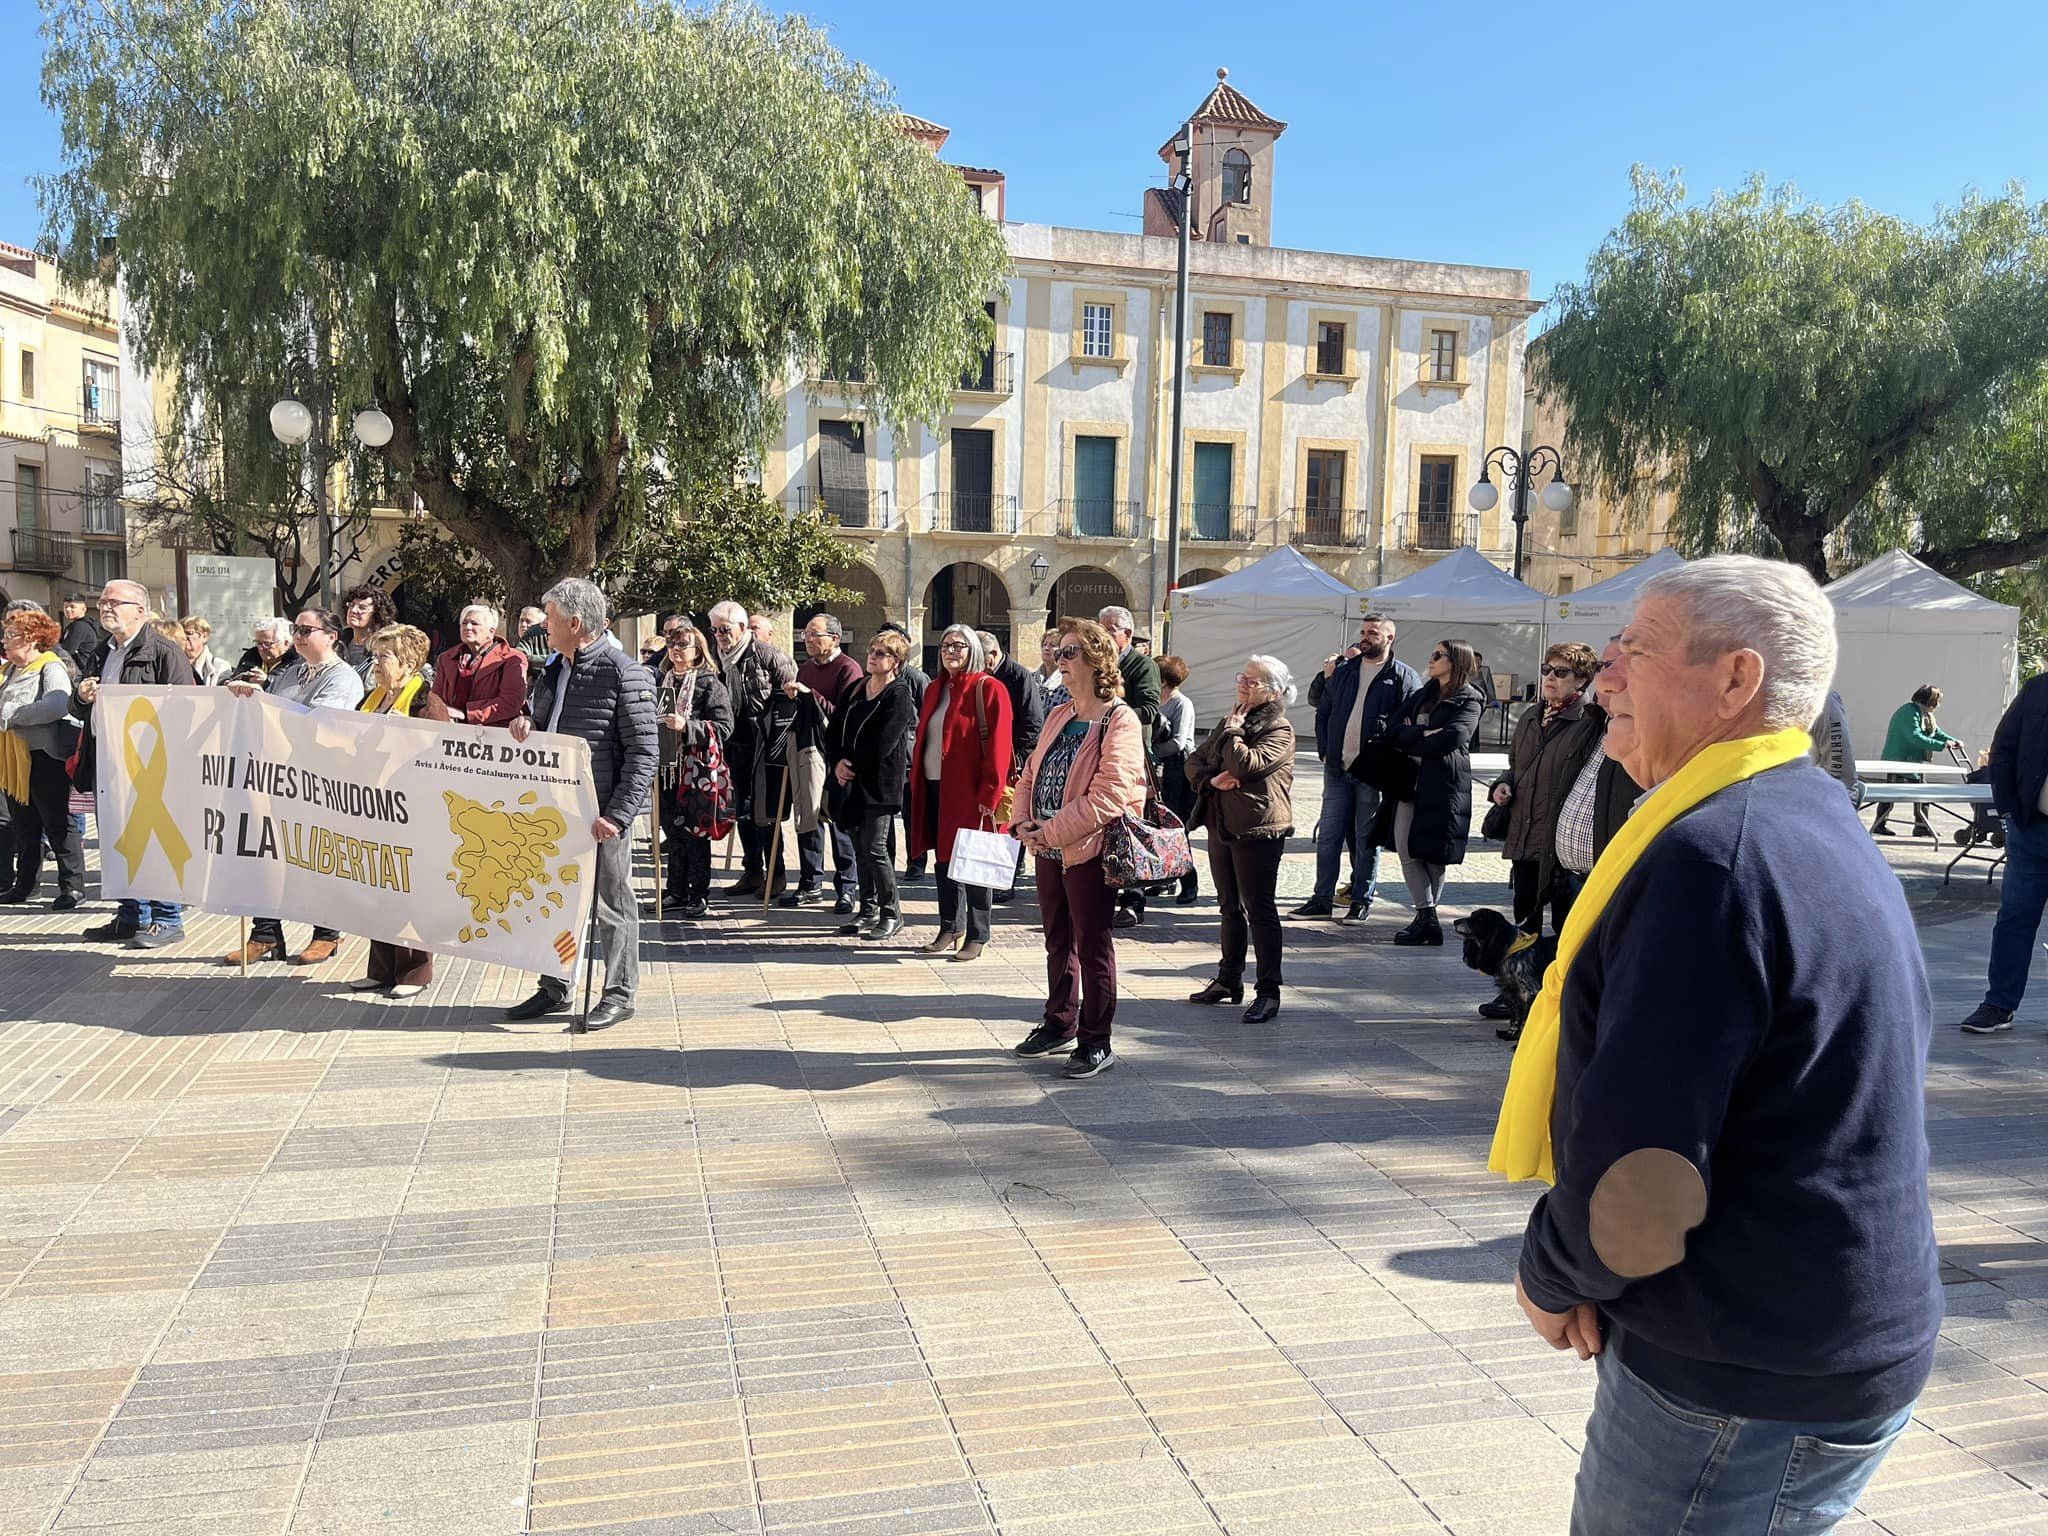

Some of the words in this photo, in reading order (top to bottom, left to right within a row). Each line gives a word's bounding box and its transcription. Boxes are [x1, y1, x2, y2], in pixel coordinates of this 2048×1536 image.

[196, 566, 215, 574] ESPAIS
[1067, 584, 1124, 594] CONFITERIA
[442, 739, 494, 761] TACA
[500, 746, 560, 768] D'OLI
[415, 760, 432, 769] Avis
[440, 760, 461, 772] Àvies
[463, 766, 474, 774] de
[476, 767, 519, 780] Catalunya
[529, 773, 538, 781] la
[541, 775, 581, 785] Llibertat
[227, 756, 236, 788] I
[243, 752, 298, 799] ÀVIES
[301, 769, 322, 806] DE
[321, 778, 409, 824] RIUDOMS
[236, 812, 279, 860] LA
[280, 820, 413, 893] LLIBERTAT
